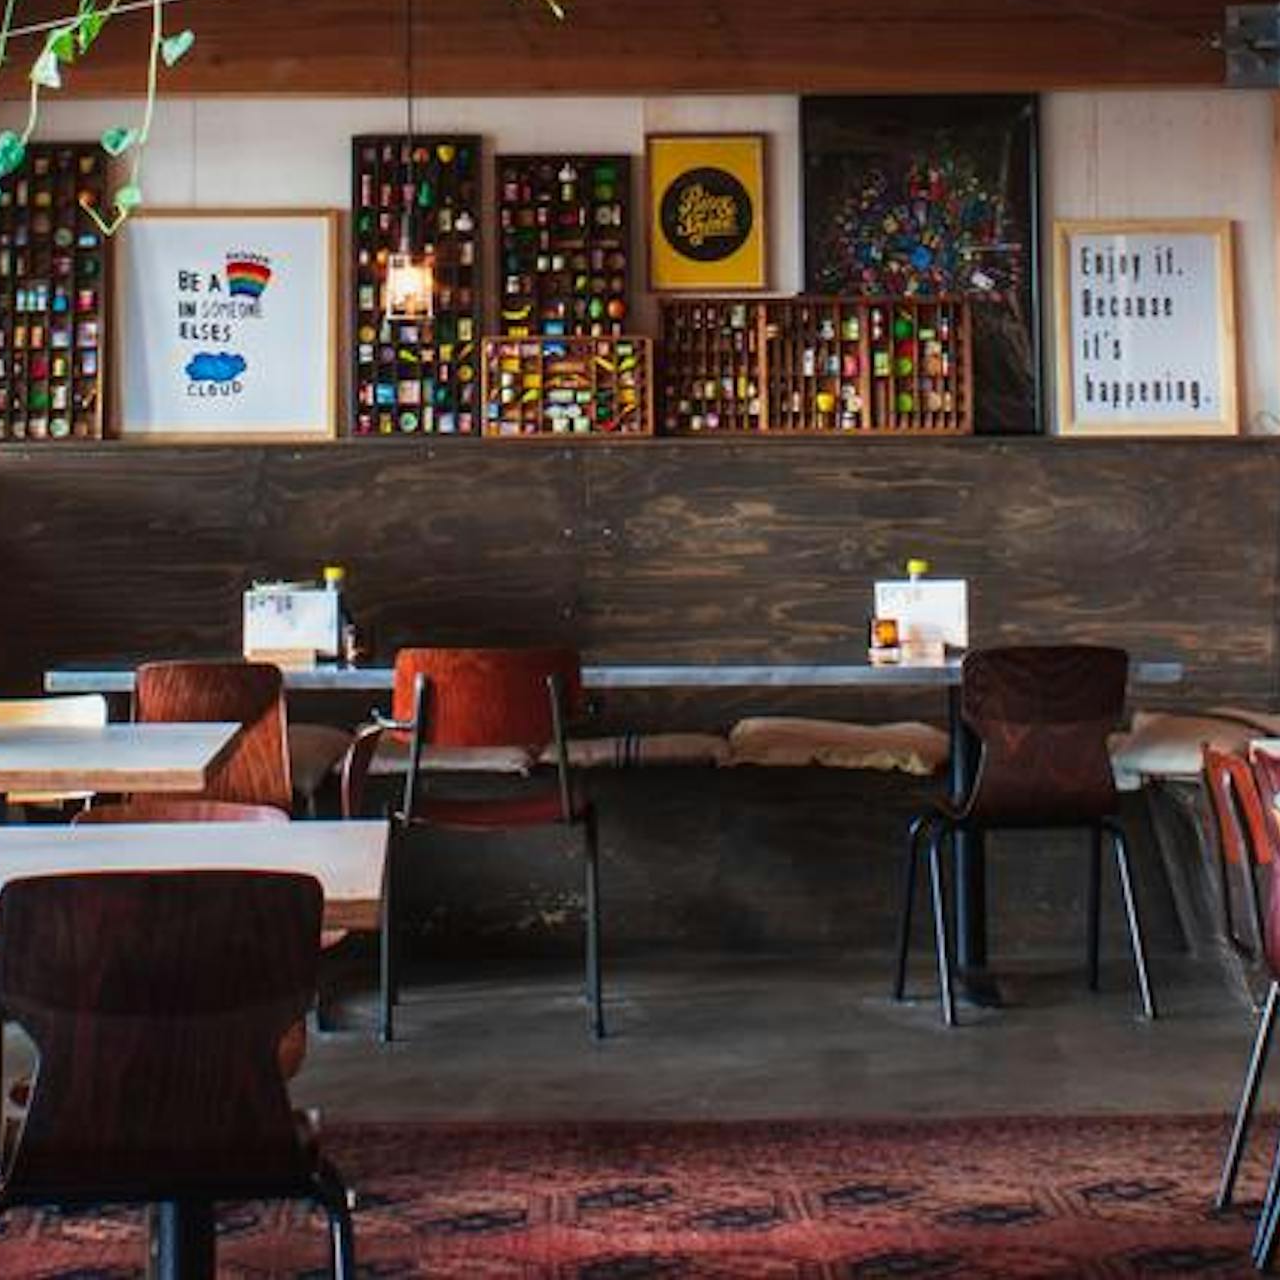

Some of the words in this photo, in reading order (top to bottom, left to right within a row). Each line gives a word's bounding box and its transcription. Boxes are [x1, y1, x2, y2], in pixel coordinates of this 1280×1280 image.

[1081, 246, 1141, 283] Enjoy
[1154, 246, 1184, 276] it.
[178, 270, 201, 292] BE
[208, 273, 221, 292] A
[178, 300, 197, 318] IN
[1082, 288, 1172, 318] Because
[179, 322, 232, 343] ELSES
[1082, 330, 1121, 360] it's
[187, 381, 243, 396] CLOUD
[1086, 372, 1212, 409] happening.
